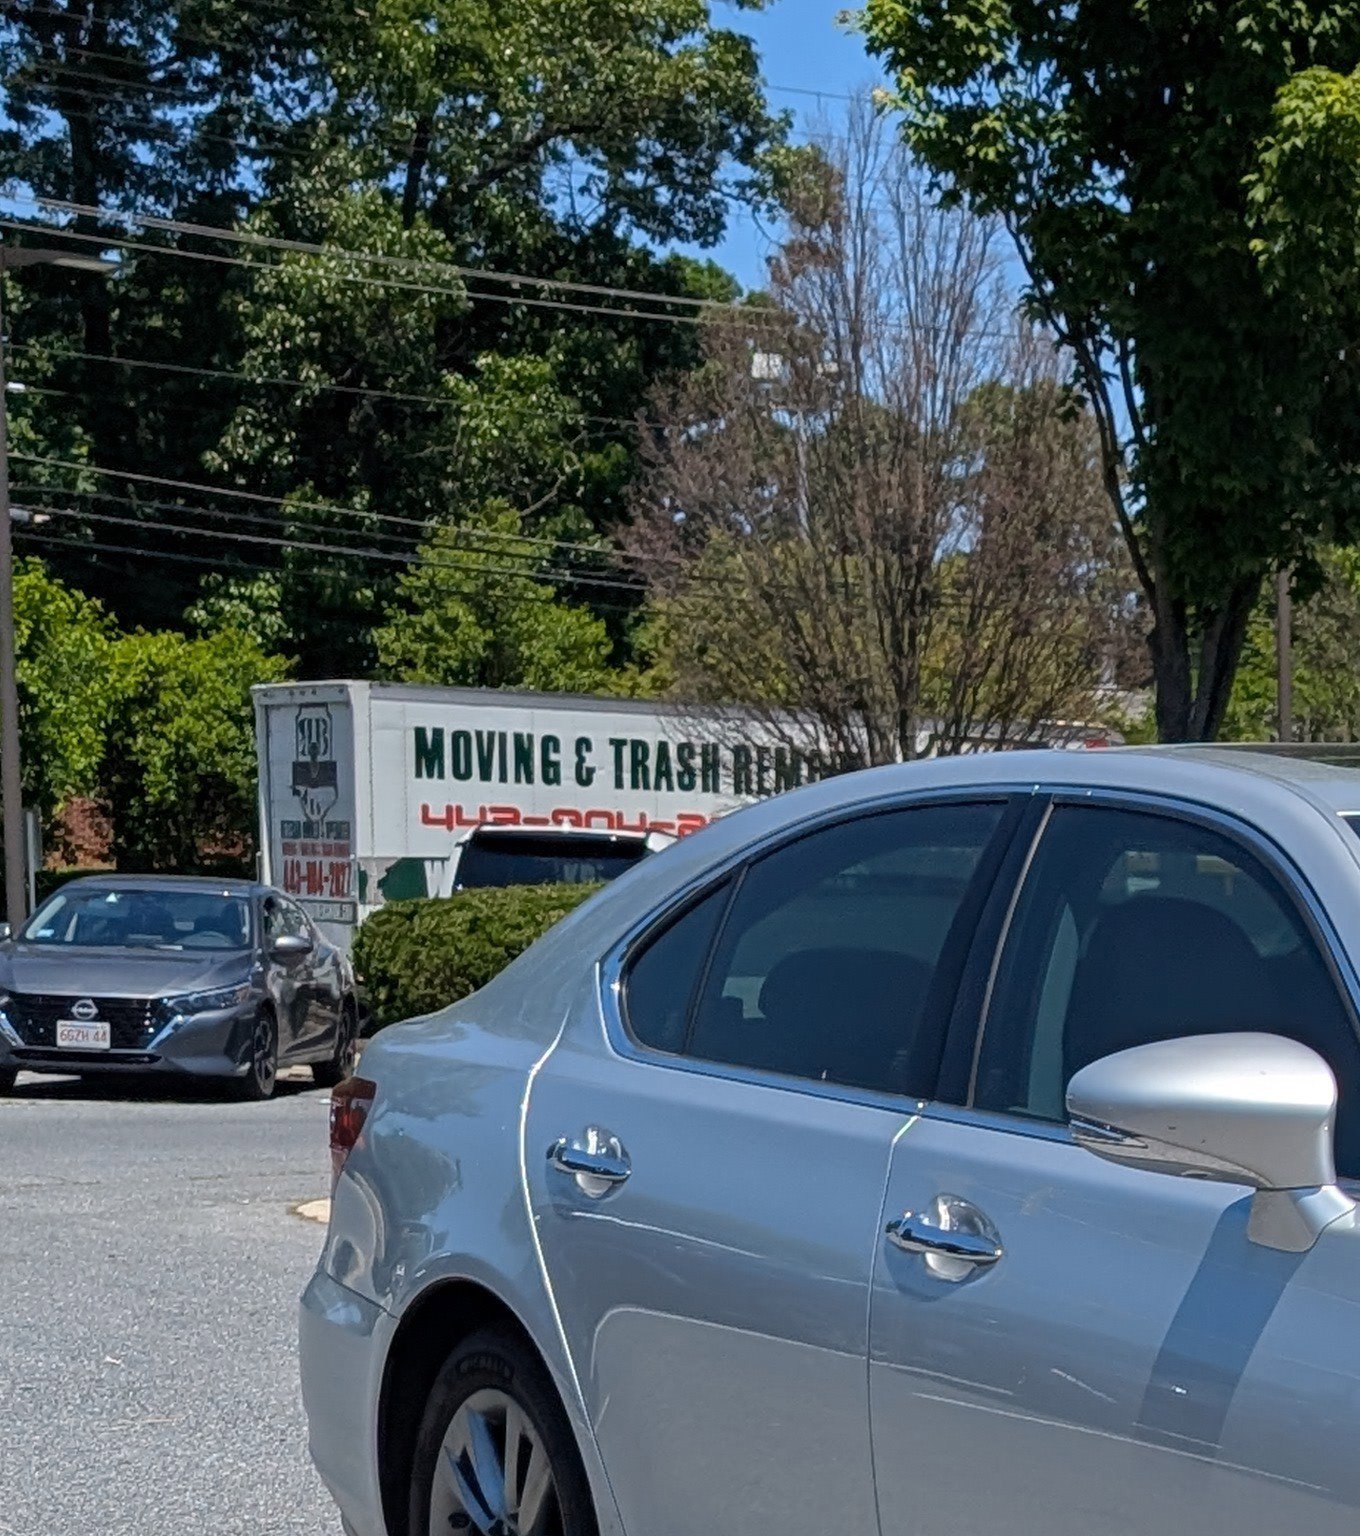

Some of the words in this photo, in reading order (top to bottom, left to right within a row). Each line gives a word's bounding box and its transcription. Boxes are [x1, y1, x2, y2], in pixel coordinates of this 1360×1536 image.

[414, 726, 561, 787] MOVING
[574, 736, 597, 787] &
[609, 738, 720, 794] TRASH
